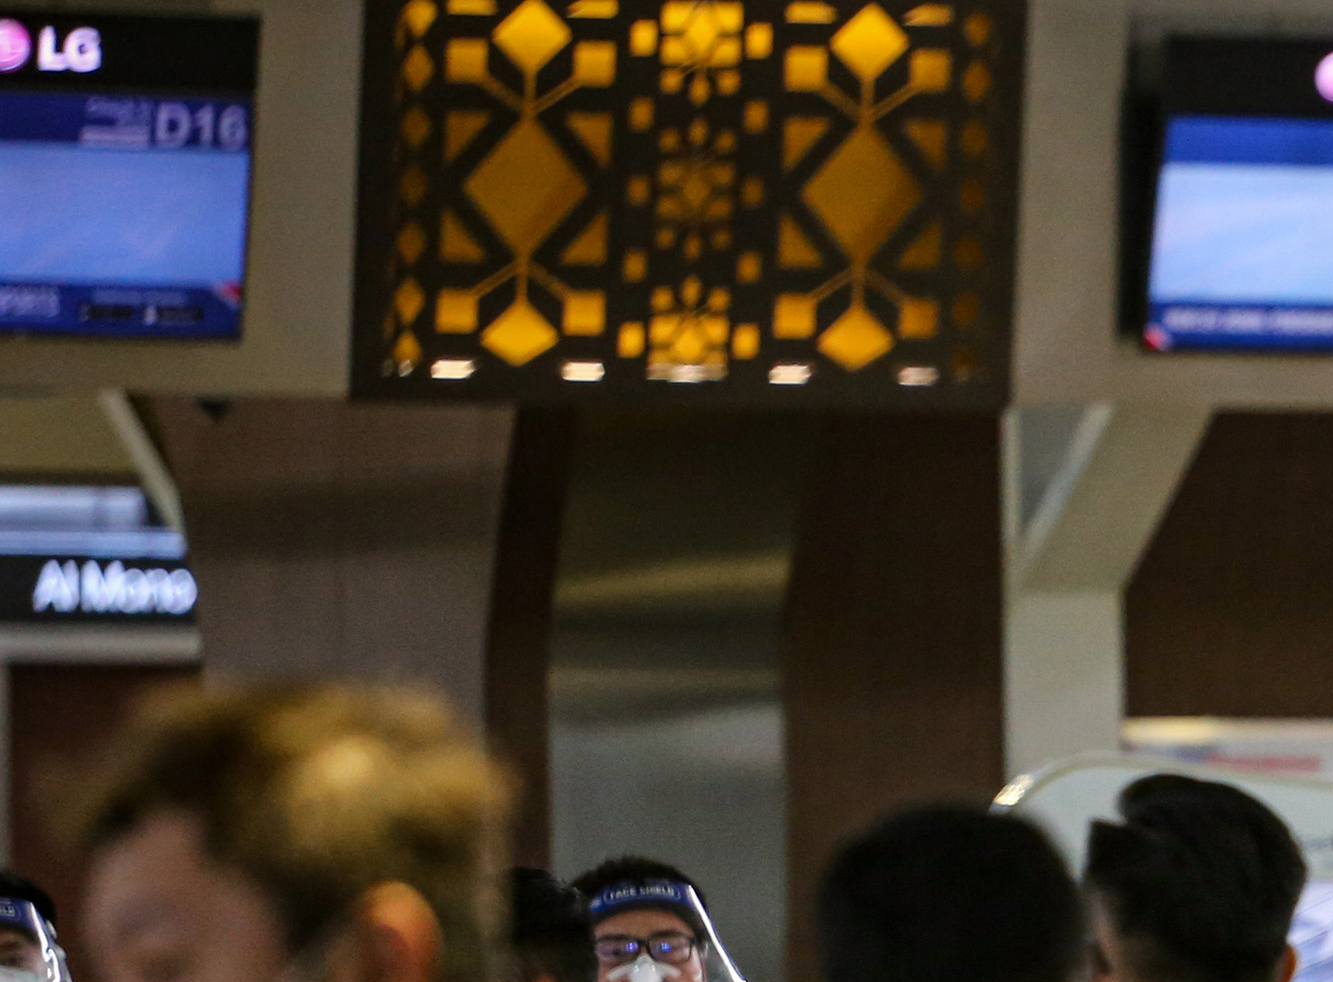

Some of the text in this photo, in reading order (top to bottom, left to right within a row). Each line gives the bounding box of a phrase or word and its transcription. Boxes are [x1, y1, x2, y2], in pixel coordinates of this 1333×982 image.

[38, 26, 101, 72] LG
[155, 102, 248, 149] D16
[609, 887, 637, 900] FACE
